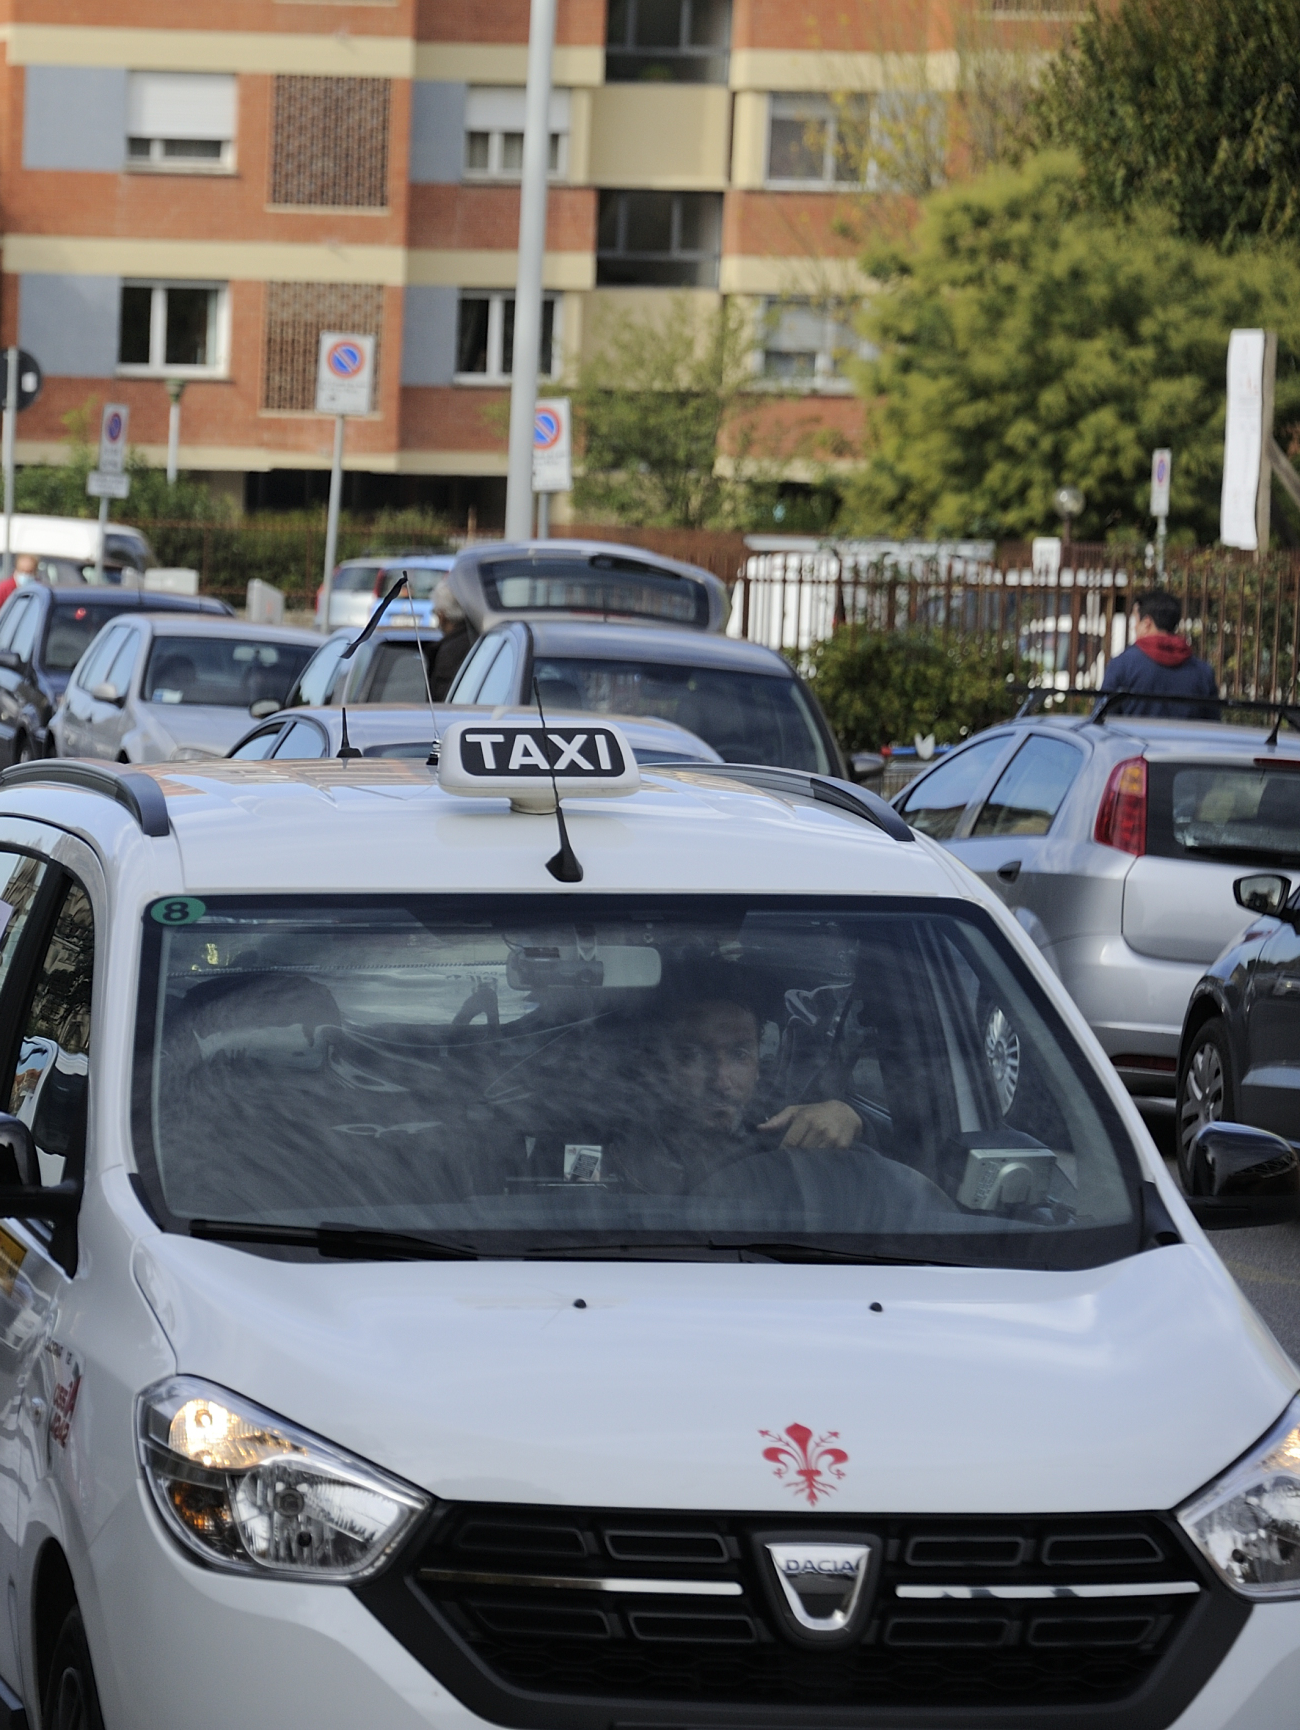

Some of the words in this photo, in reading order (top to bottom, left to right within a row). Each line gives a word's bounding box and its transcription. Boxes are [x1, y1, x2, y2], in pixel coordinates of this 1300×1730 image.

[465, 733, 612, 770] TAXI
[162, 901, 189, 922] 8
[784, 1559, 856, 1574] DACIA
